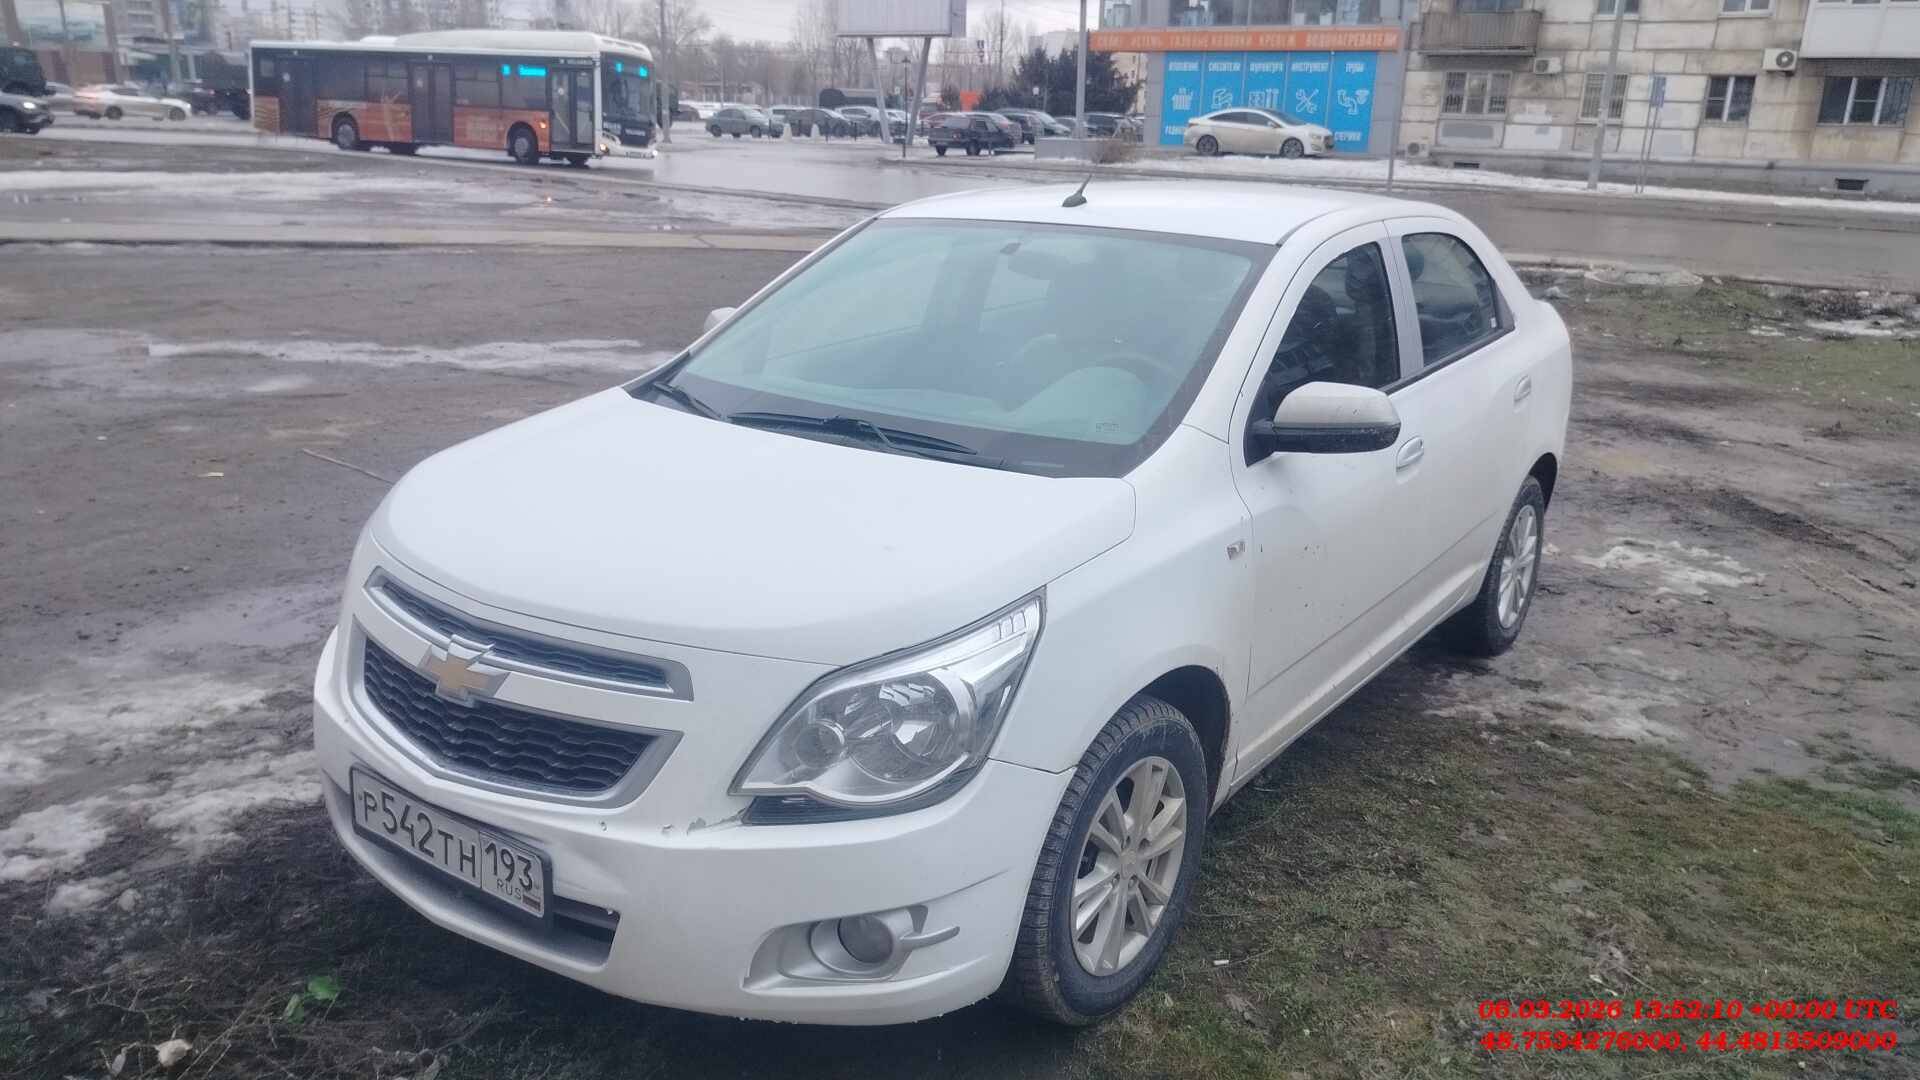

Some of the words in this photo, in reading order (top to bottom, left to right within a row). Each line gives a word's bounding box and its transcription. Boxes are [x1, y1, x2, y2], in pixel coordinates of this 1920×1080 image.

[362, 790, 476, 879] Р542ТН
[485, 842, 533, 892] 193
[496, 879, 522, 900] RUS
